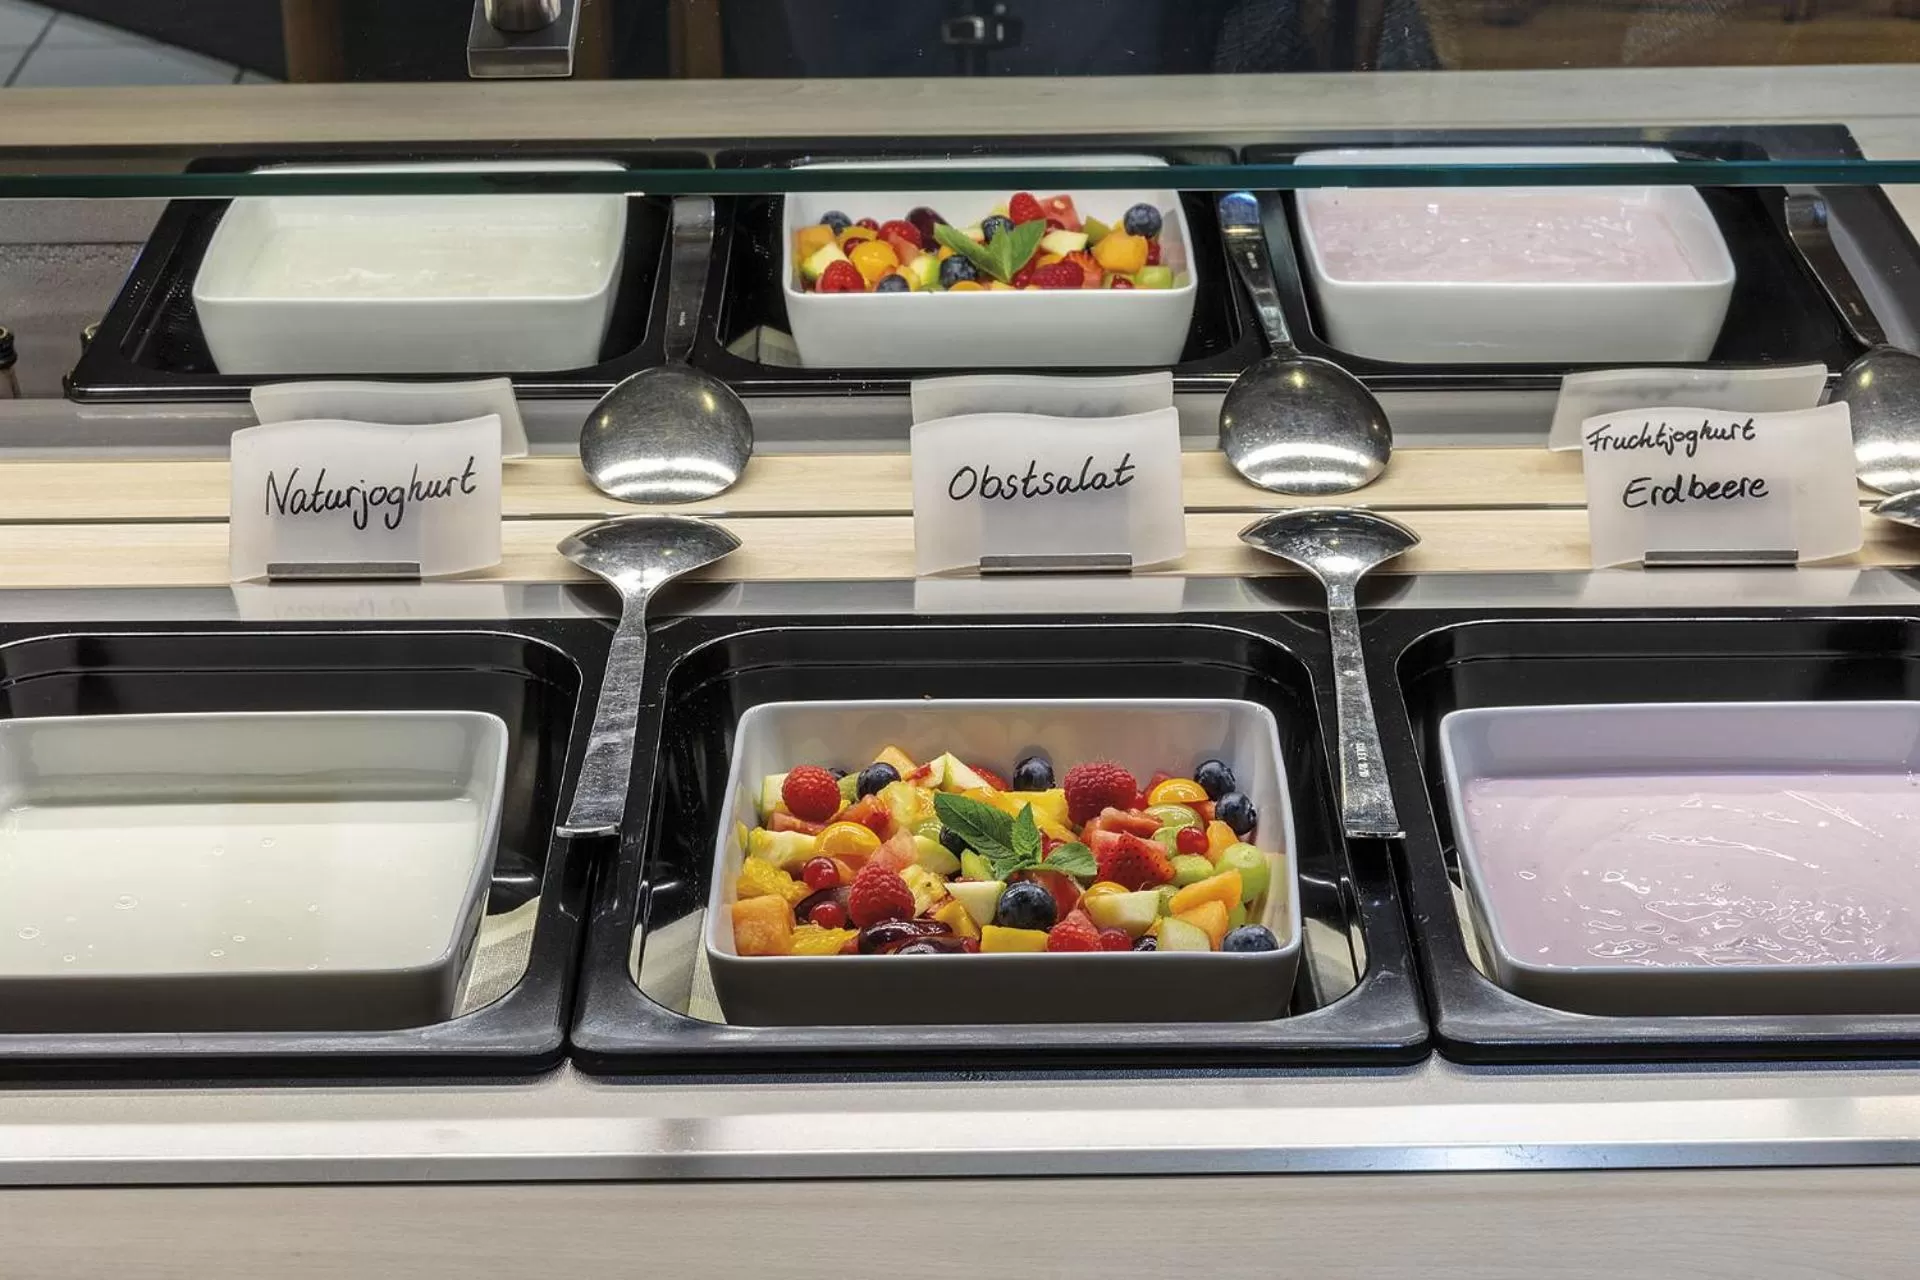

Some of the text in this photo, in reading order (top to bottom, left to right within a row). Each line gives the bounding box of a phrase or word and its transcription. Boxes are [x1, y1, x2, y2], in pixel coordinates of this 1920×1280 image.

[1586, 418, 1756, 458] Fruchtjoghurt
[265, 455, 477, 531] Naturjoghurt
[948, 452, 1136, 501] Obstsalat
[1622, 473, 1770, 509] Erdbeere
